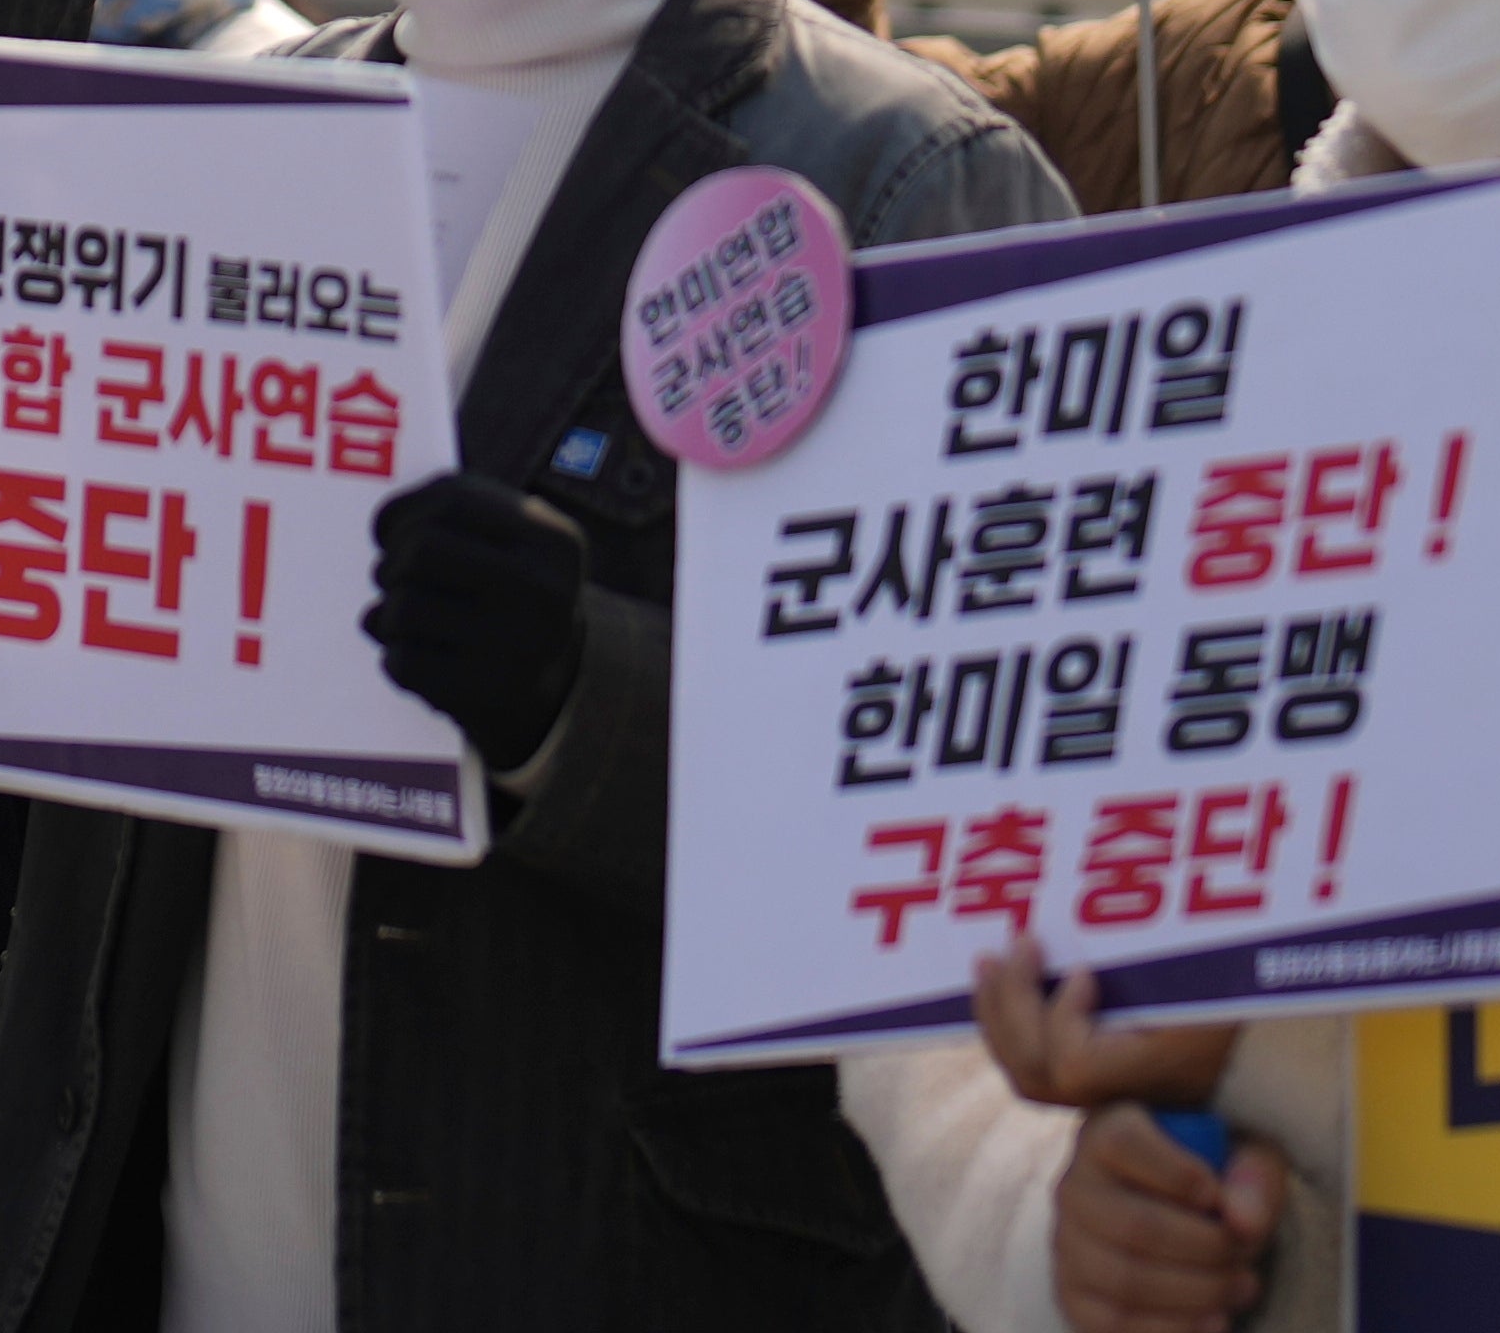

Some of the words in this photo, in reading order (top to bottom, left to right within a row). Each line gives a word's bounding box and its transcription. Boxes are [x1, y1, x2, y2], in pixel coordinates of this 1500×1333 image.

[206, 254, 402, 344] 불러오는
[95, 340, 402, 479] 군사연습
[943, 296, 1245, 460] 한미일
[759, 470, 1160, 640] 군사훈련
[833, 631, 1135, 794] 한미일
[1158, 609, 1379, 758] 동맹
[849, 805, 1050, 950] 구축
